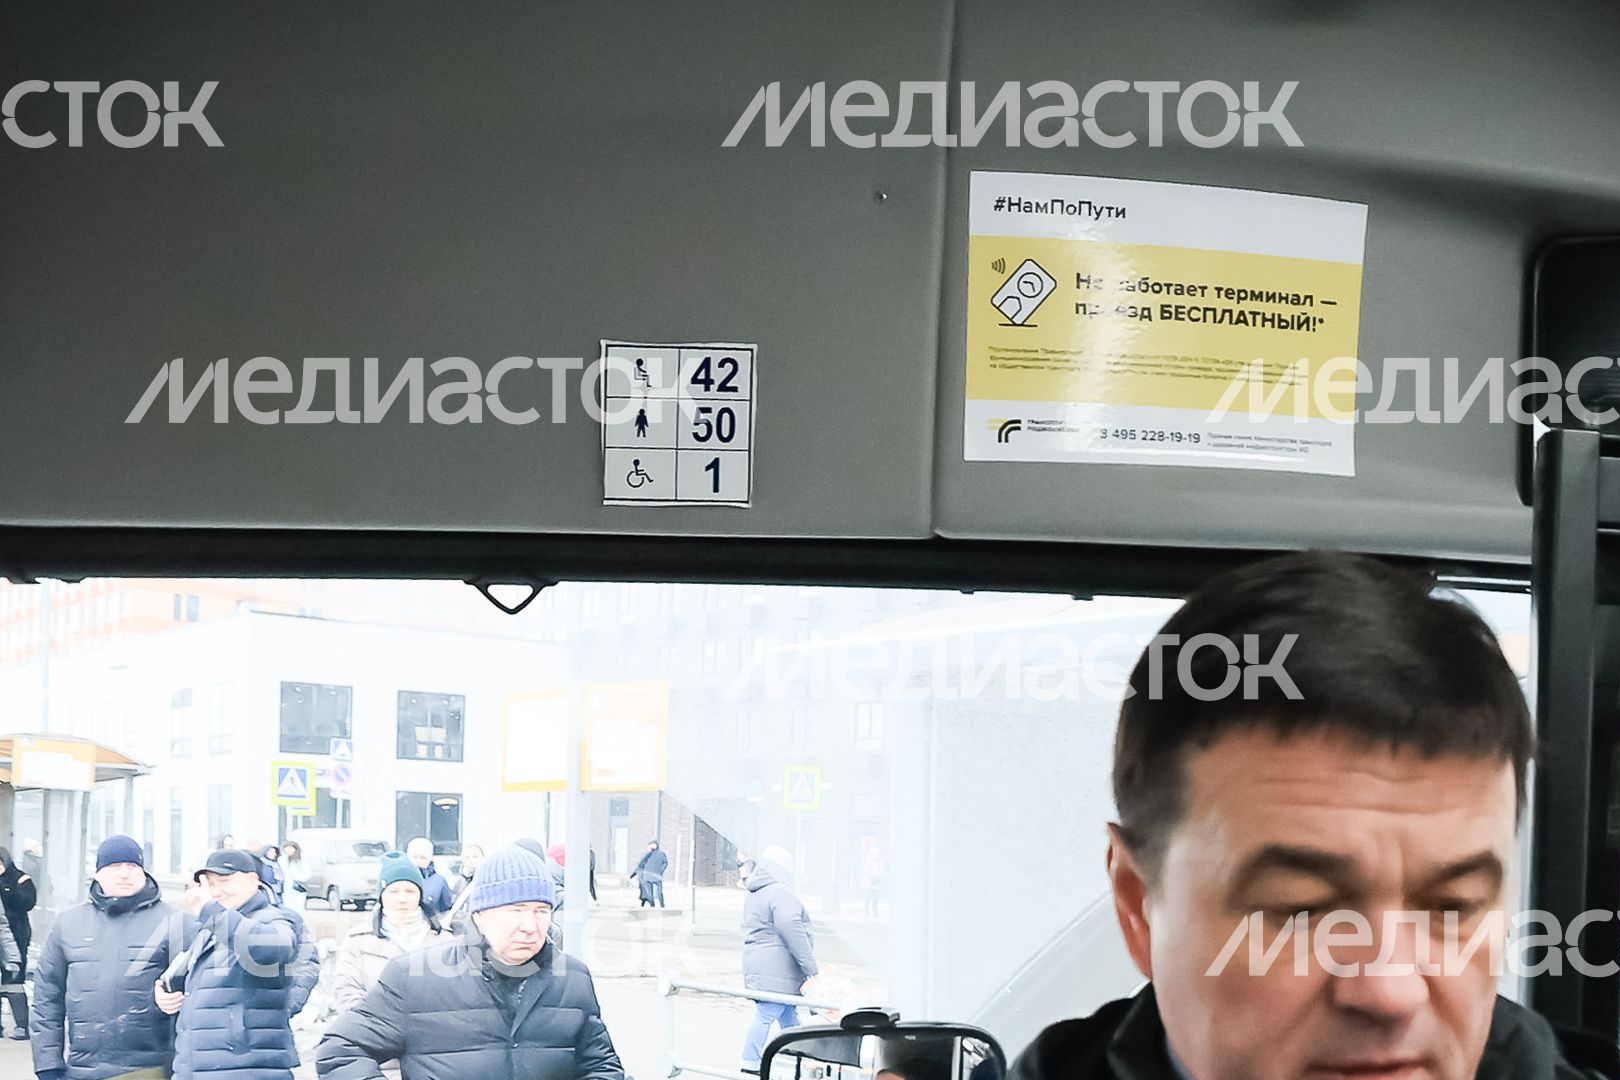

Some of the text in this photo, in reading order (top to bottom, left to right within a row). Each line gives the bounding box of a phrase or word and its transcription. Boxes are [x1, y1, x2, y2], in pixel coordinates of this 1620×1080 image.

[993, 196, 1127, 221] #НамПоПути
[1111, 276, 1208, 298] аботает
[1214, 286, 1313, 307] терминал
[691, 357, 739, 393] 42
[692, 407, 736, 443] 50
[1112, 429, 1137, 440] 495
[1141, 430, 1200, 444] 228-19-19
[705, 457, 720, 493] 1
